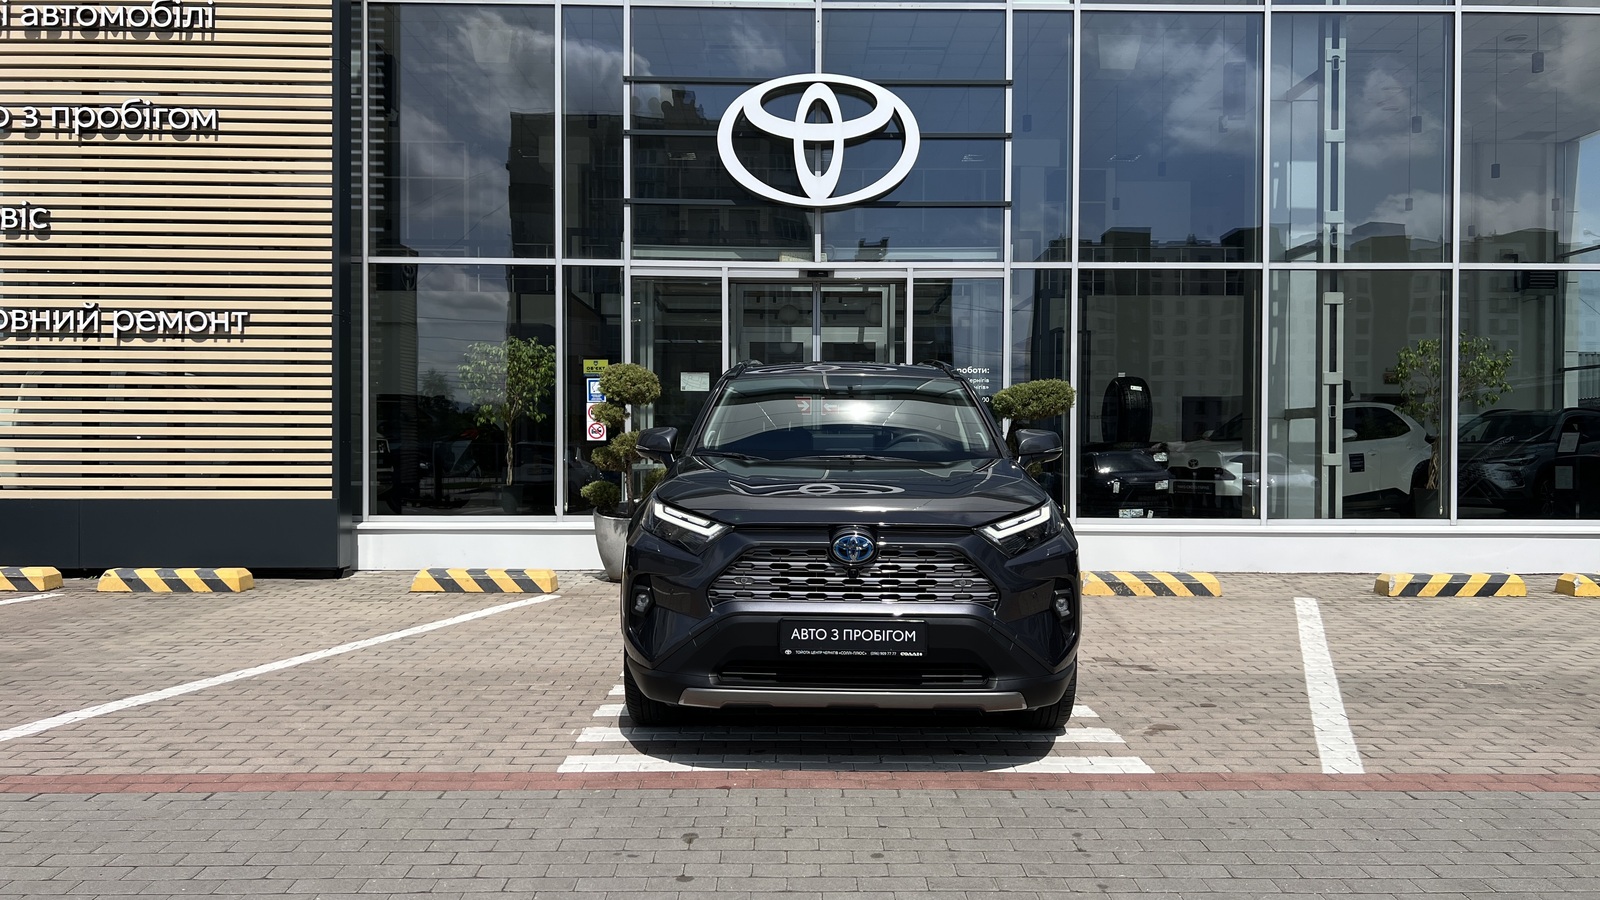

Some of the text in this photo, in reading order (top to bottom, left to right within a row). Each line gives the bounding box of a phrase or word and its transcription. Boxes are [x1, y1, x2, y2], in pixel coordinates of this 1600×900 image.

[20, 0, 214, 28] автомобілі
[22, 106, 39, 128] з
[52, 98, 218, 135] пробігом
[2, 200, 48, 229] віс
[113, 310, 249, 338] ремонт
[791, 628, 917, 642] АВТО З ПРОБІГОМ
